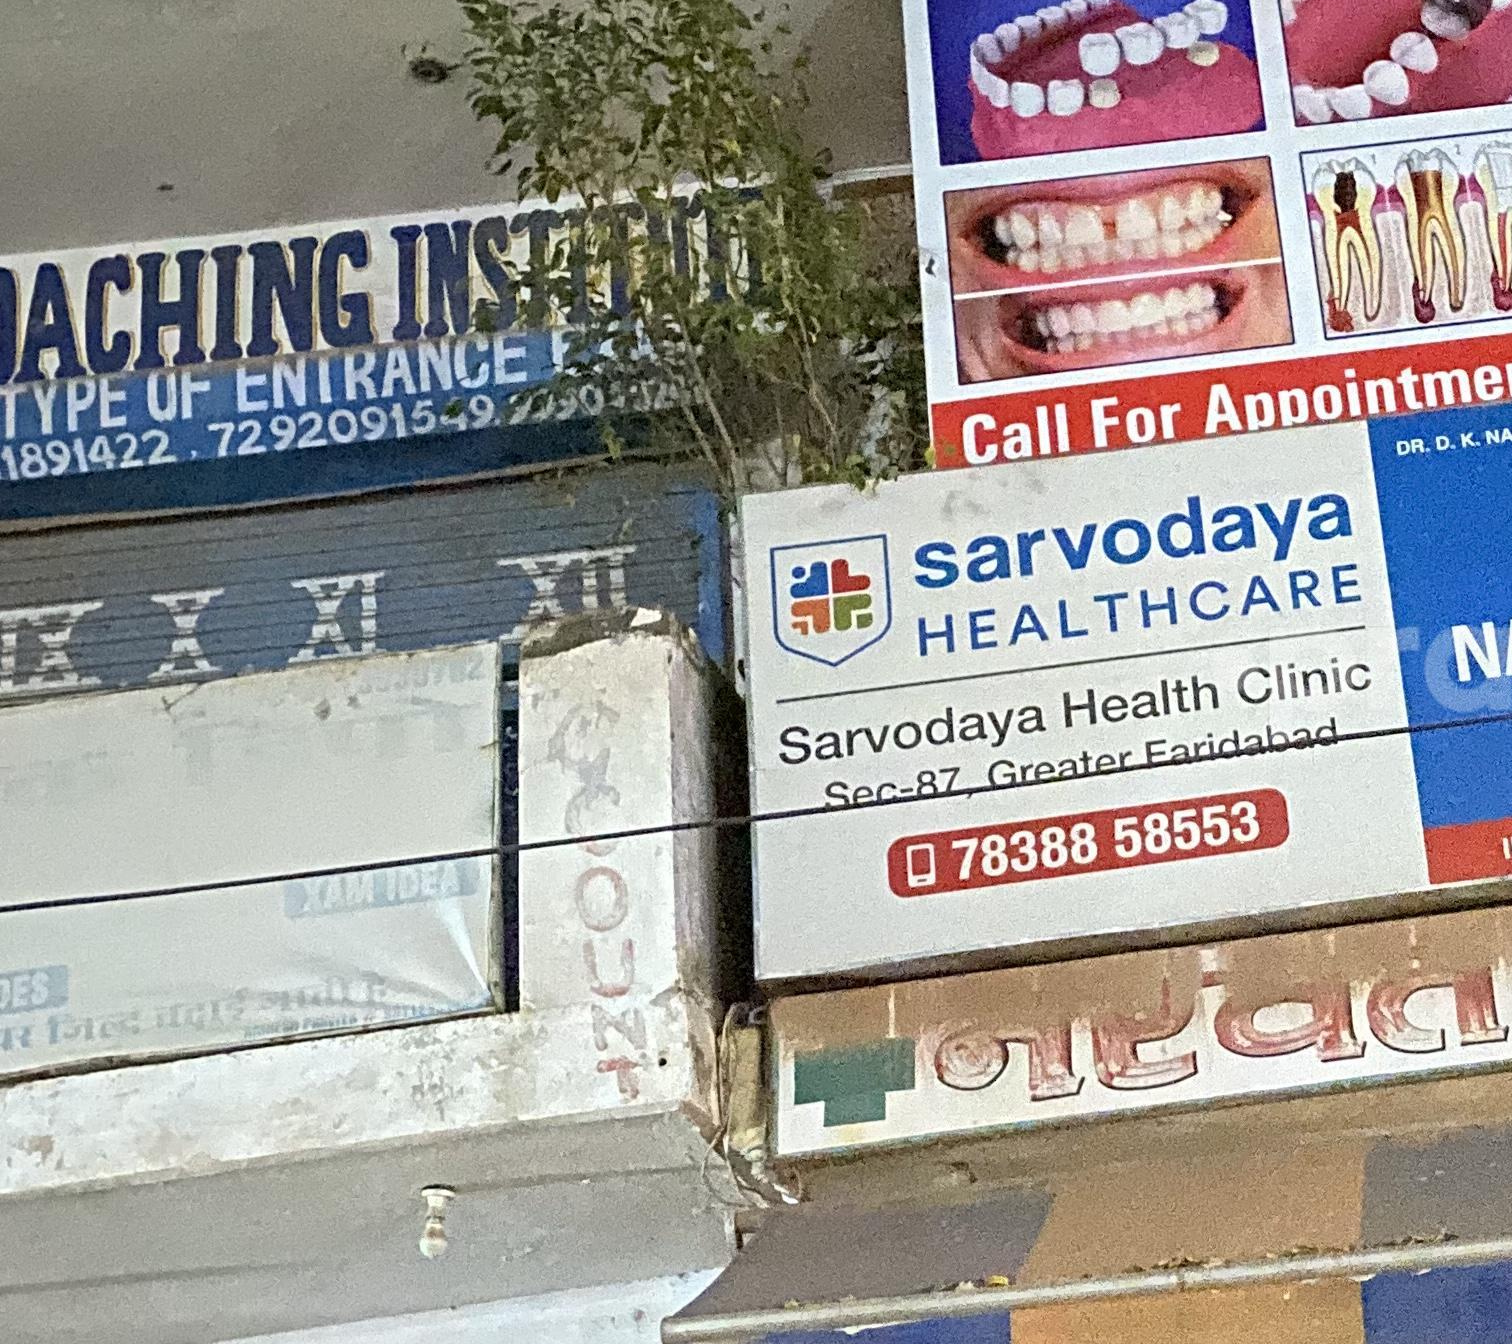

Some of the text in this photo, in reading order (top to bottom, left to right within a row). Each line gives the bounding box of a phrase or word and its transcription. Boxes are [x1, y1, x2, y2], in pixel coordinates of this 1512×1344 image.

[0, 378, 127, 440] TYPE
[147, 371, 211, 422] OF
[237, 332, 527, 413] ENTRANCE
[962, 400, 1071, 466] Call
[1090, 396, 1181, 449] For
[1396, 440, 1430, 456] DR.
[1436, 435, 1456, 451] D.
[1461, 432, 1481, 448] K.
[912, 491, 1354, 588] sarvodaya
[916, 563, 1364, 658] HEALTHCARE
[778, 656, 1373, 765] Sarvodaya Health Clinic
[987, 746, 1133, 789] Greater
[1144, 717, 1339, 769] Faridabad
[951, 801, 1262, 881] 78388 58553
